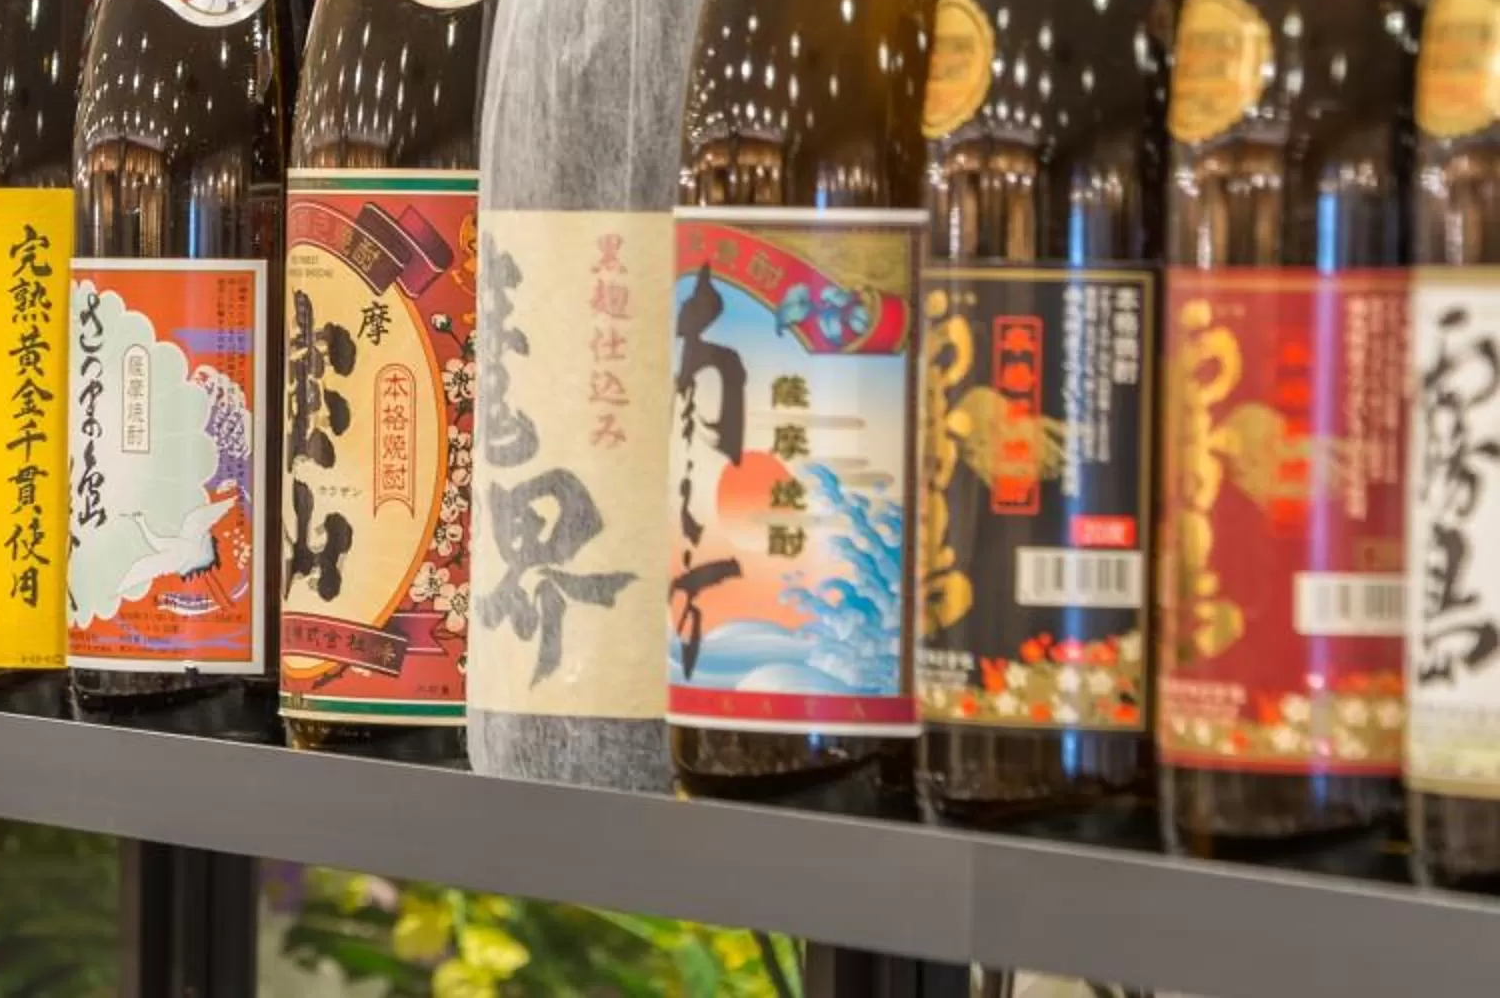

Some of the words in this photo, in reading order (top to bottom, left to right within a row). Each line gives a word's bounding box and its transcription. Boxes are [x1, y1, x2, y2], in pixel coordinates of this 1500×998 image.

[3, 224, 54, 608] 完熟黄金千貫使用
[383, 373, 409, 490] 本格焼酎
[588, 233, 630, 450] 黒麹仕込み
[768, 374, 811, 560] 薩摩焼酎
